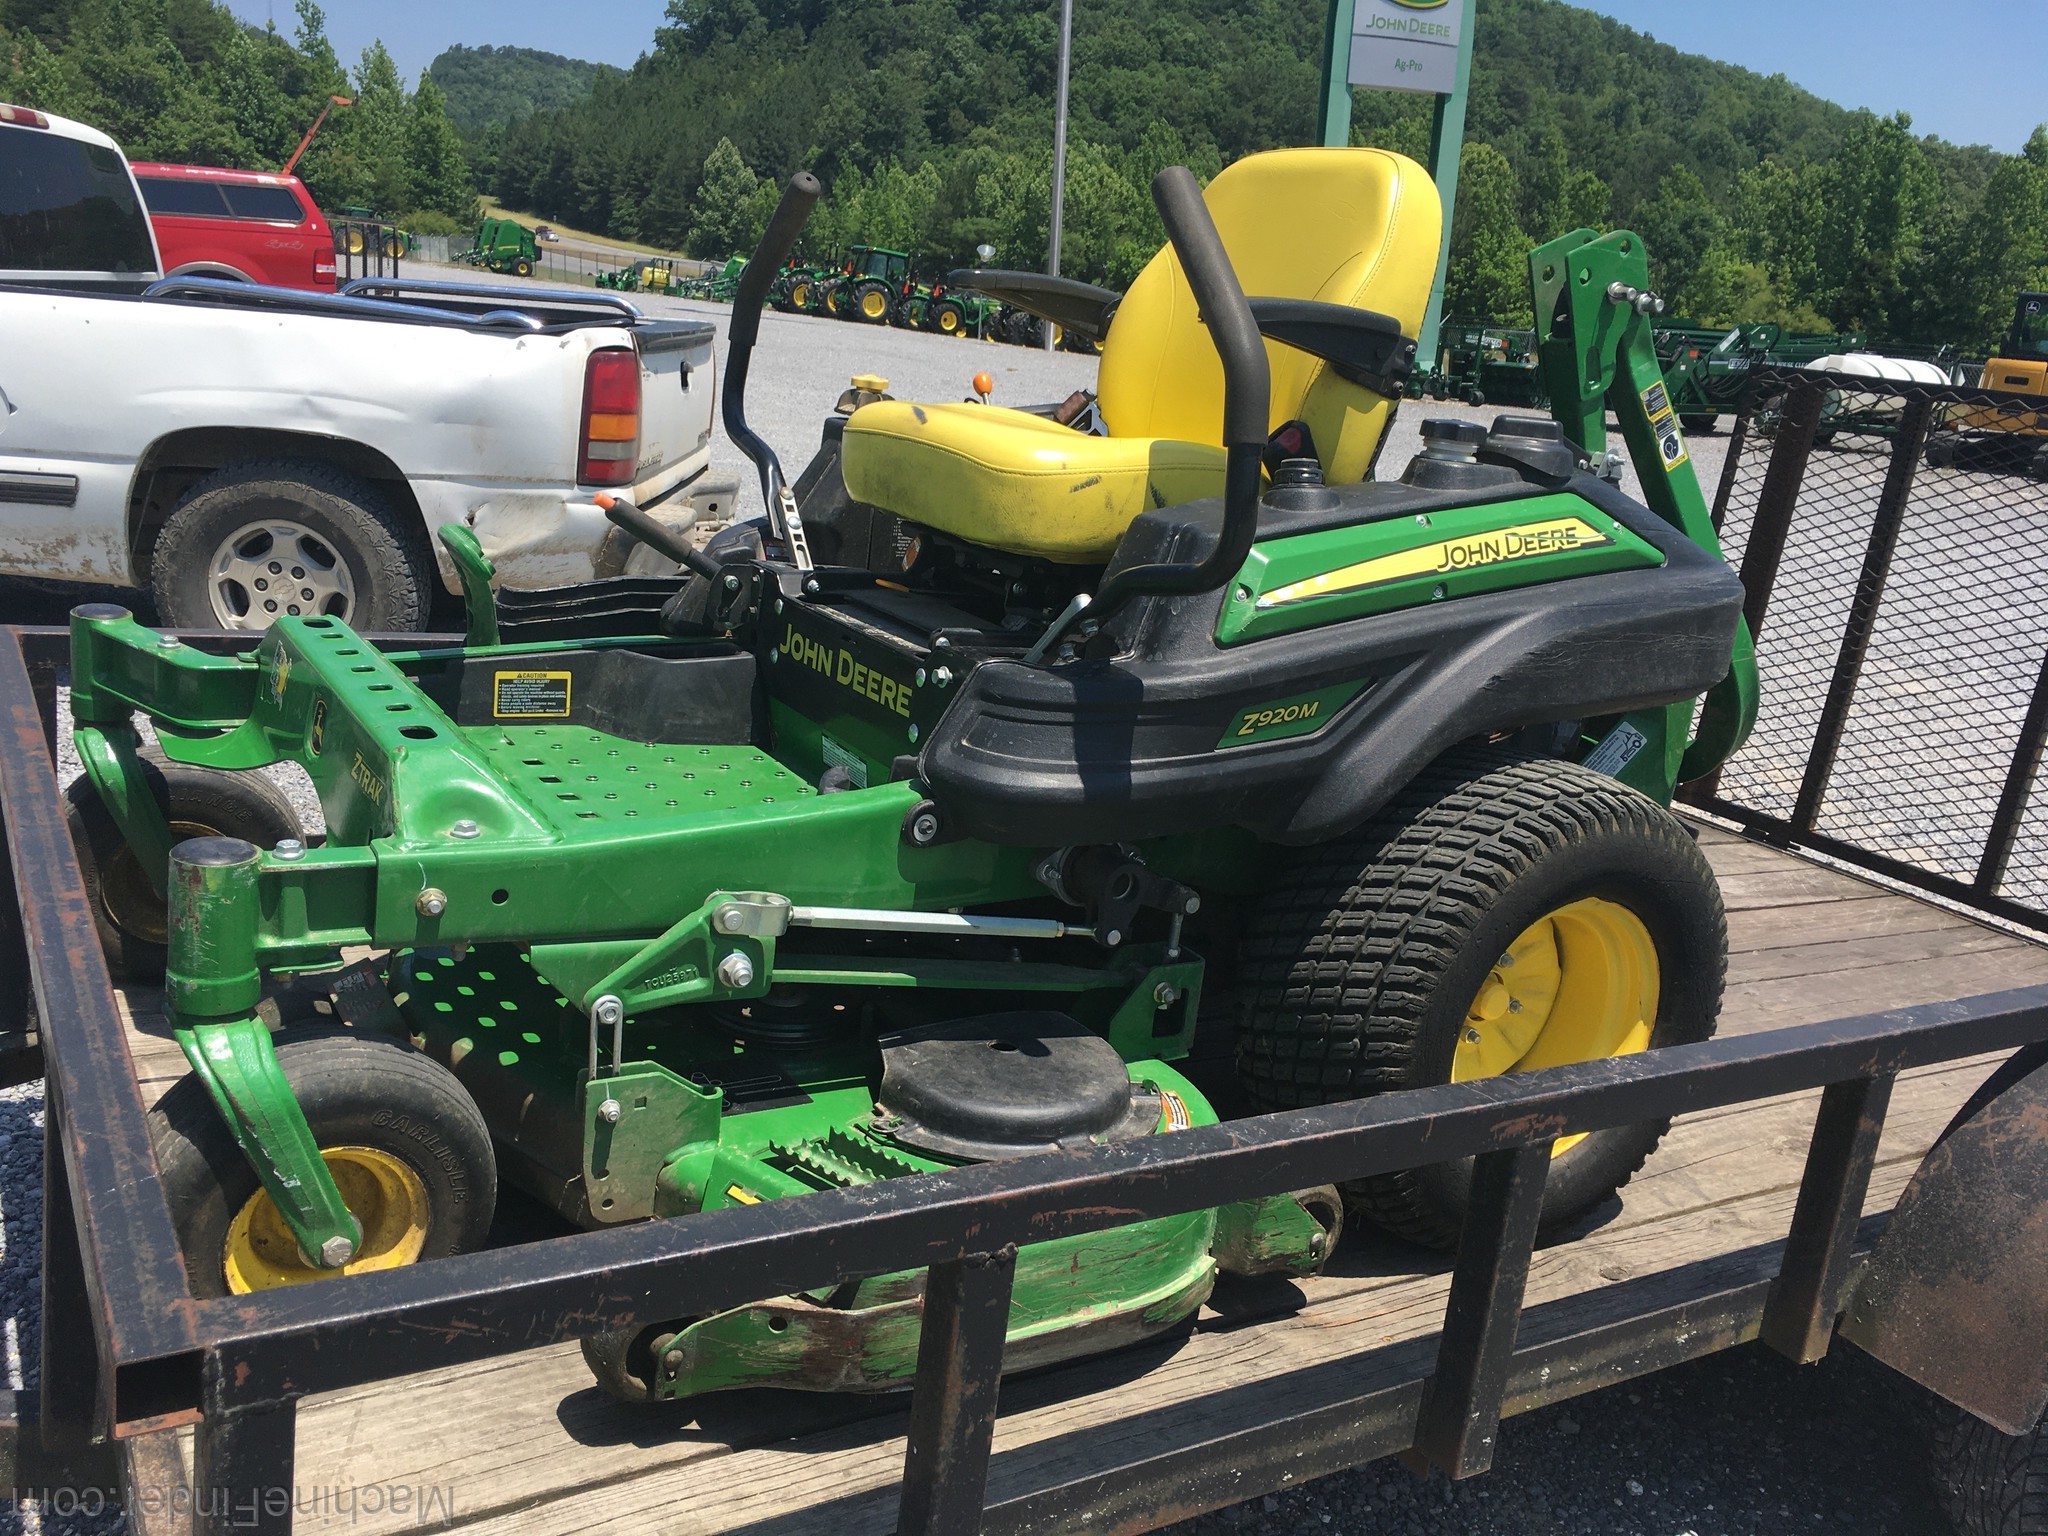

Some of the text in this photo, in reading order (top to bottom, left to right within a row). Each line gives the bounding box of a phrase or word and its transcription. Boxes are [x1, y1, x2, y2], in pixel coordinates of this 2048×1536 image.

[1365, 13, 1451, 38] JOHN DEERE
[1394, 57, 1423, 73] Ag-Pro
[1437, 526, 1579, 570] JOHN DEERE
[779, 623, 913, 718] JOHN DEERE
[1237, 701, 1319, 736] Z920M
[350, 751, 384, 807] ZTRAK
[371, 1109, 470, 1204] CARLISLE
